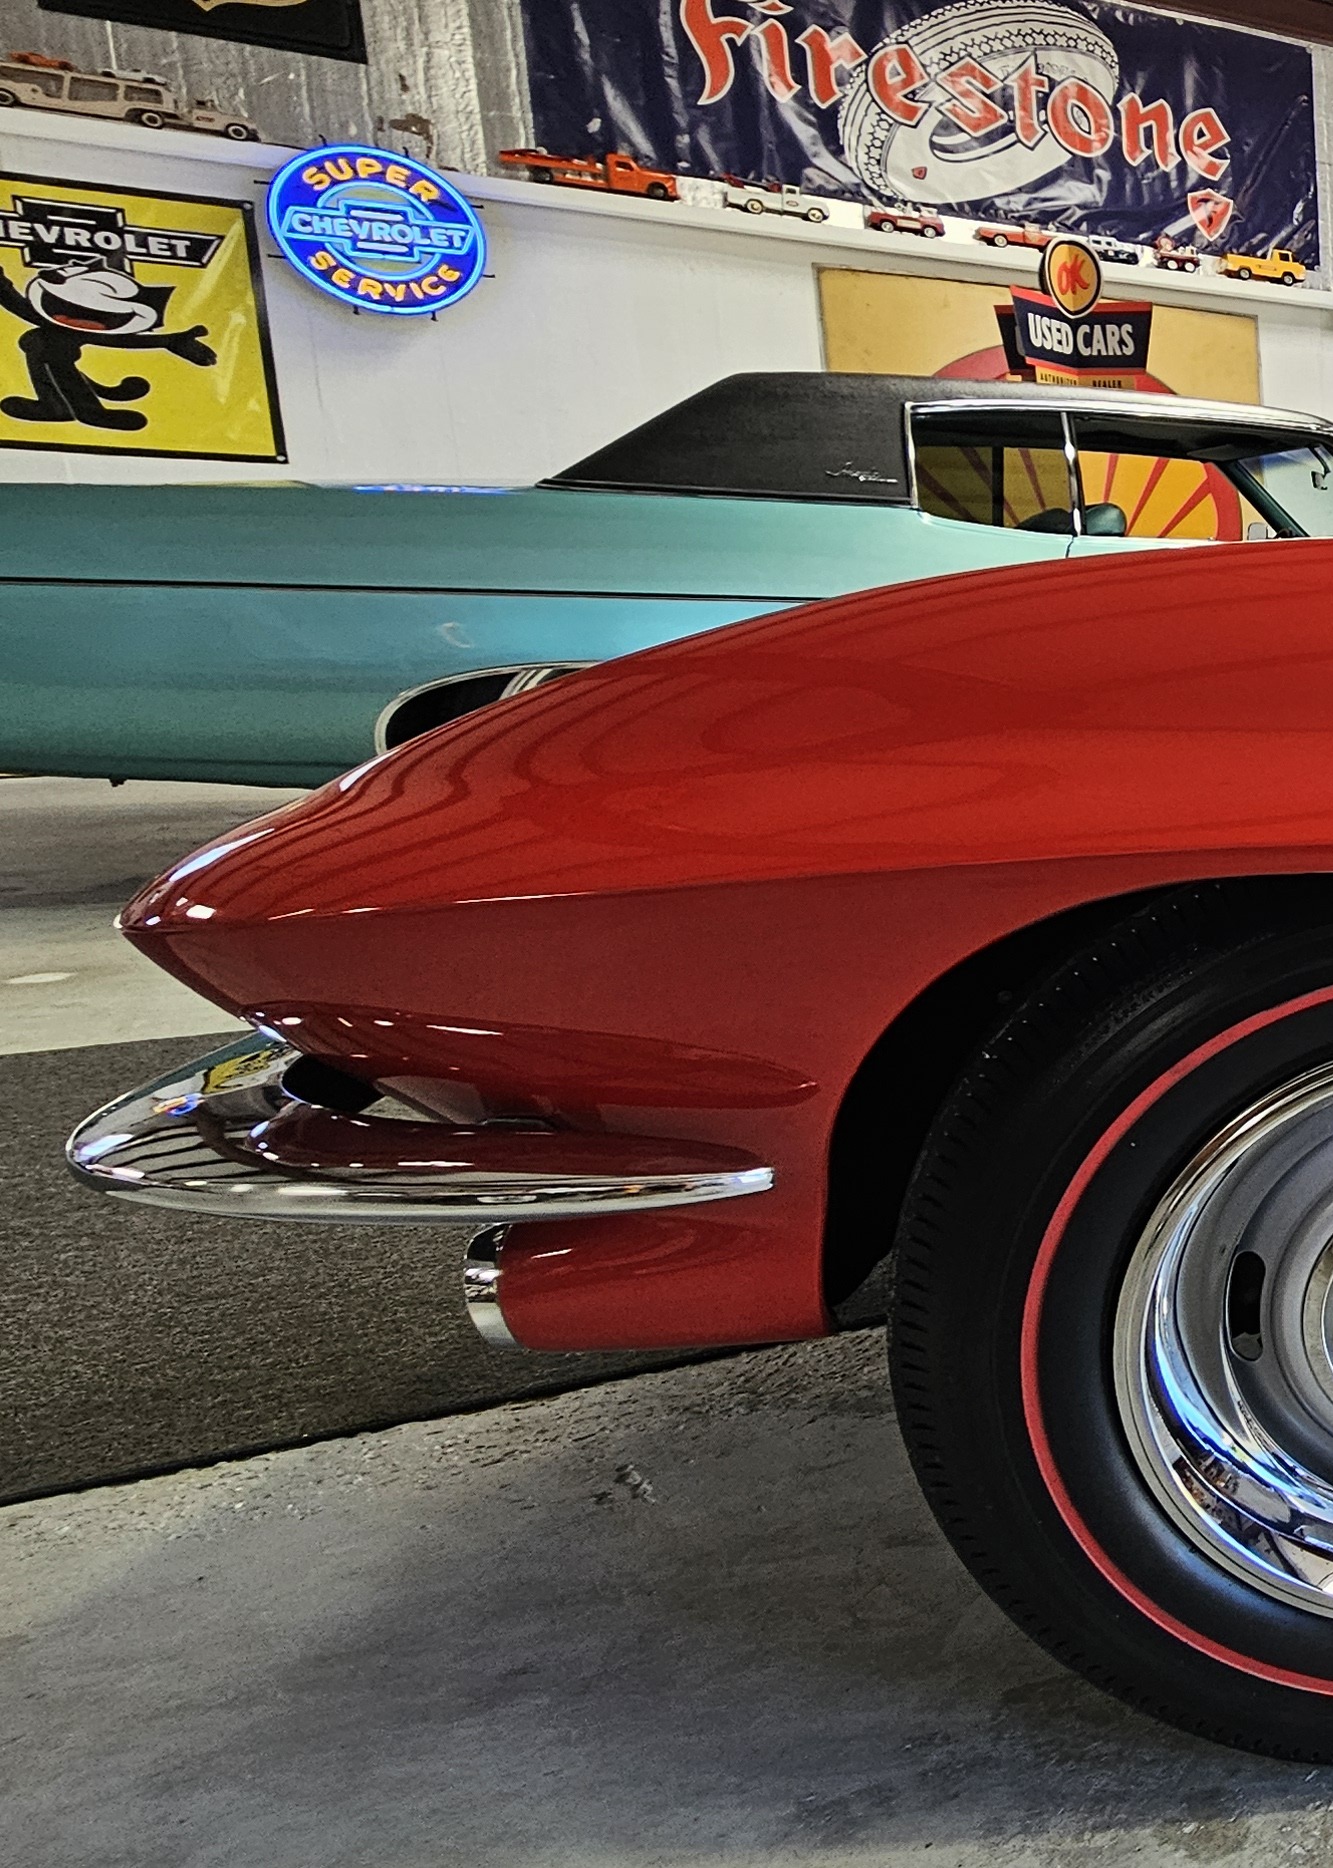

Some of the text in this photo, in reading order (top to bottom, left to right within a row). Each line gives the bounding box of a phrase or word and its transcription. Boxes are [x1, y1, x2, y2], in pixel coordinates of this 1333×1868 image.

[681, 0, 1231, 181] Firestone
[302, 157, 440, 202] SUPER
[0, 219, 192, 258] EVROLET
[291, 213, 466, 247] CHEVROLET
[310, 251, 461, 302] SERVICE
[1057, 253, 1090, 296] OK
[1027, 312, 1135, 356] USED CARS
